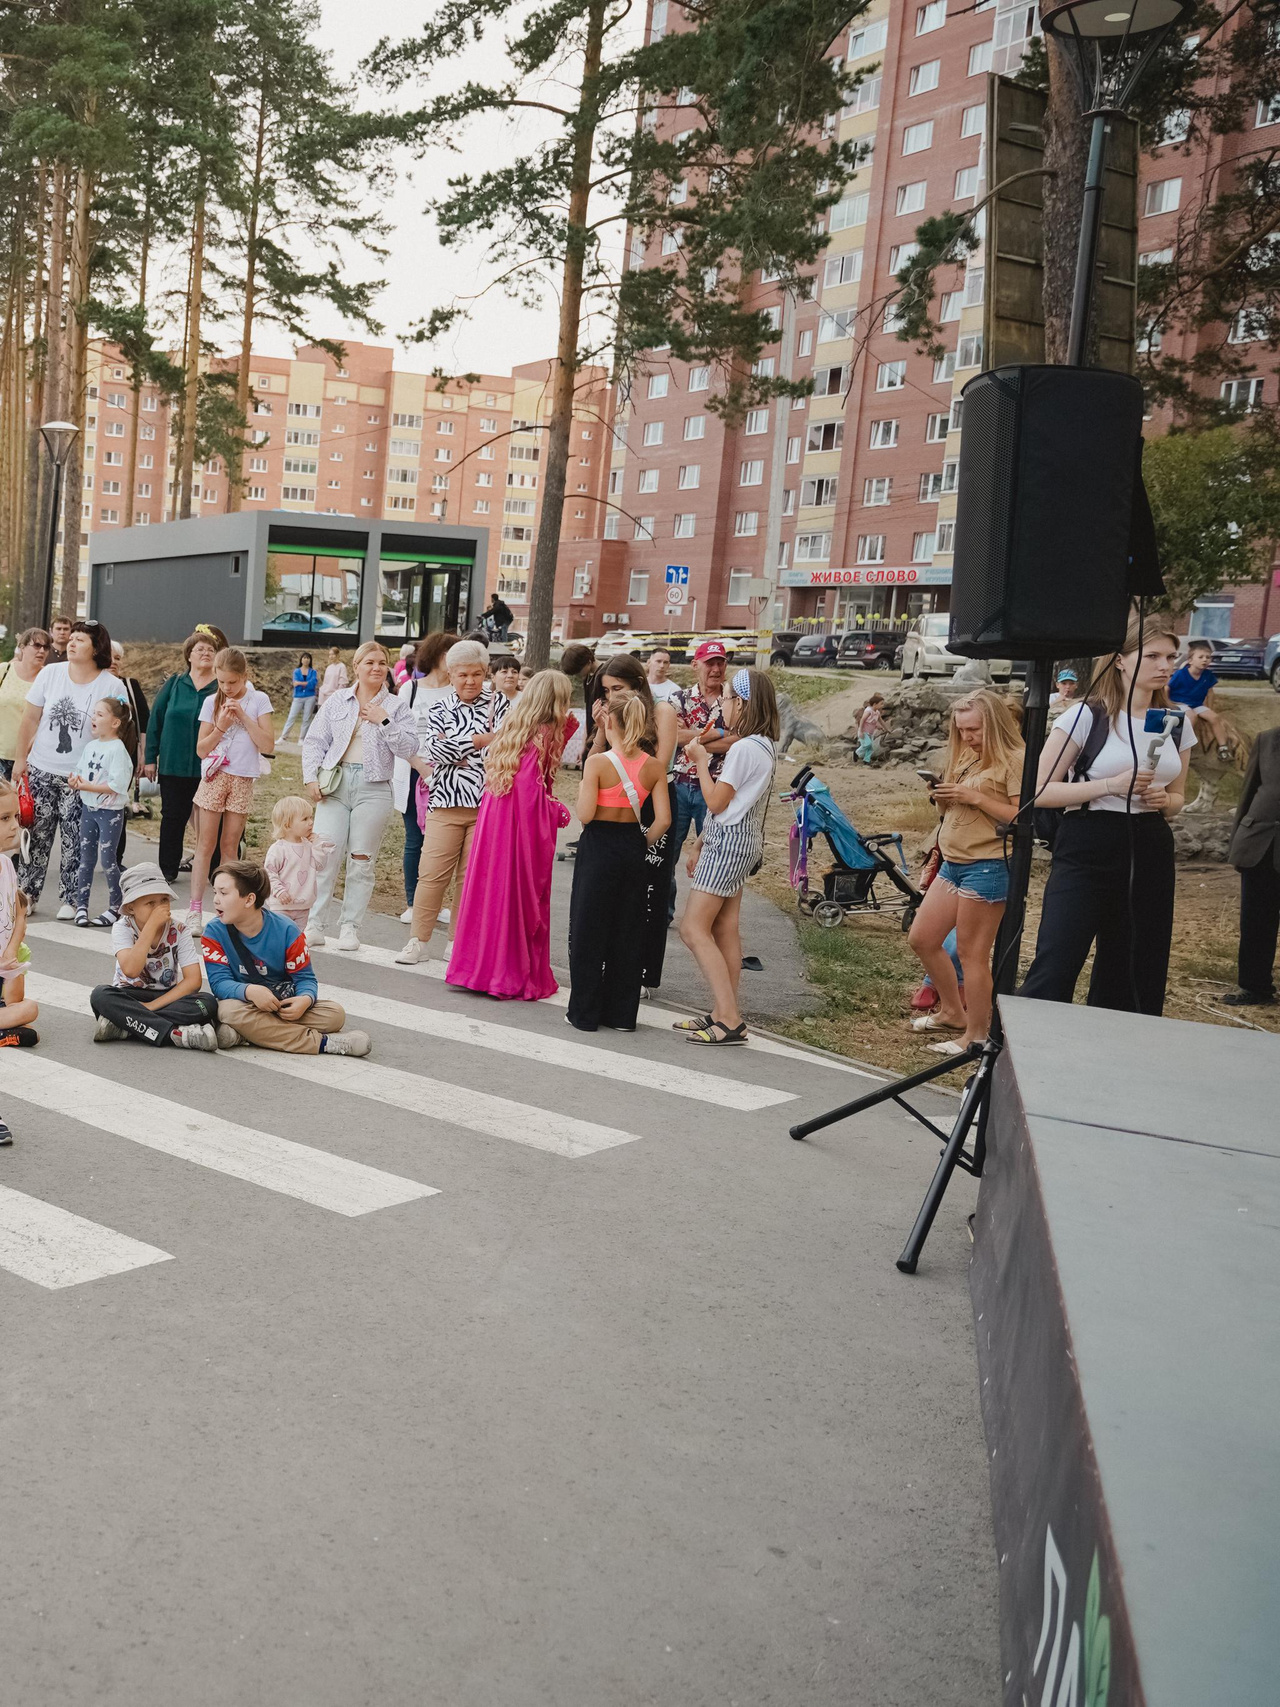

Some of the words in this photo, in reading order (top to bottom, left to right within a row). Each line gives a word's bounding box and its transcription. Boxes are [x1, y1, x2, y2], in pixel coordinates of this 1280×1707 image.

[810, 571, 862, 584] ЖИВОЕ
[865, 569, 918, 583] СЛОВО
[670, 591, 680, 599] 60
